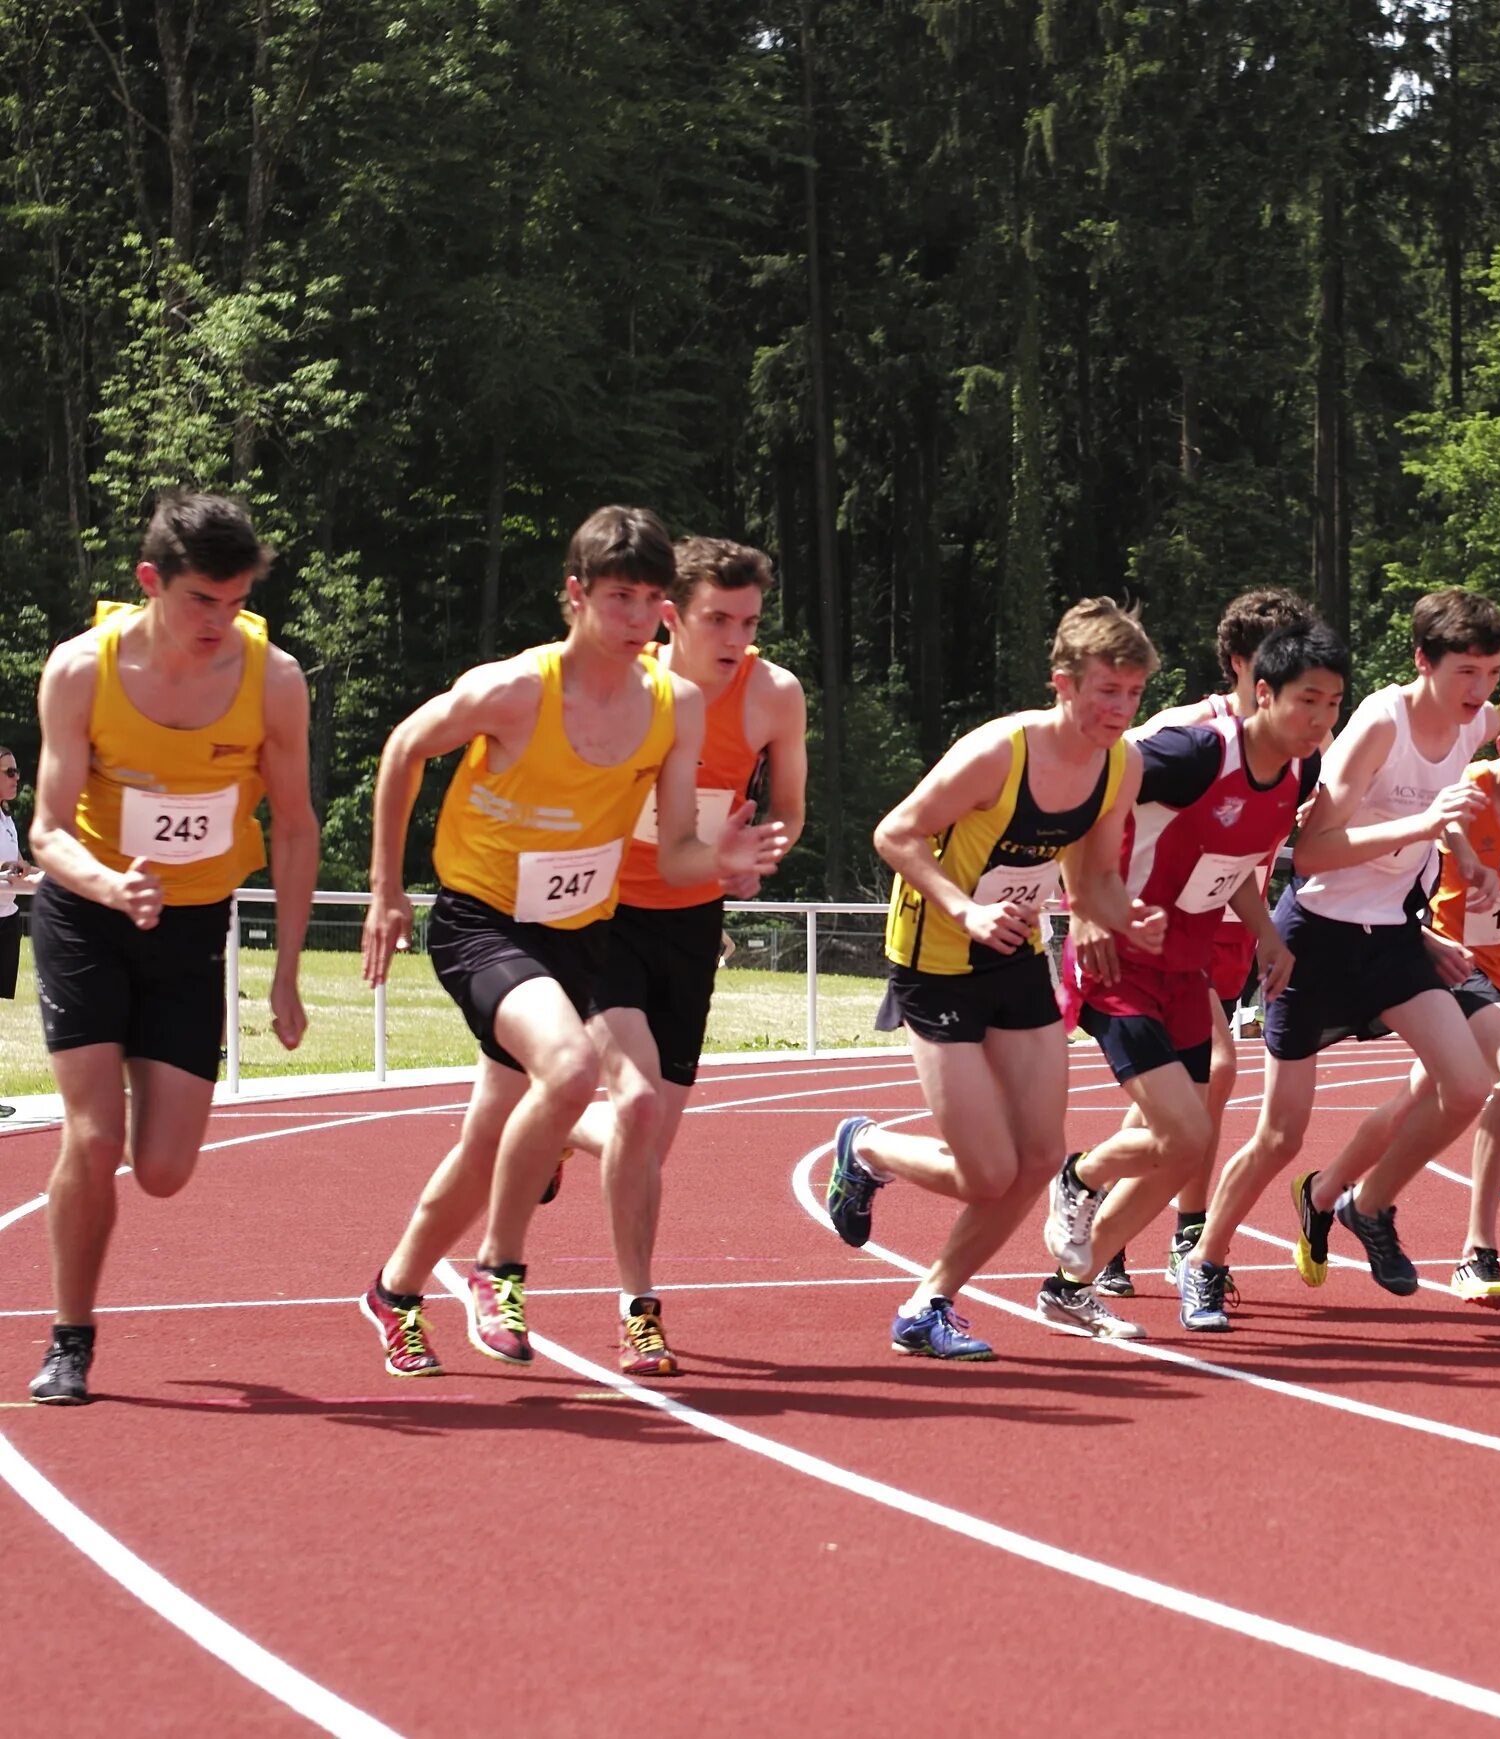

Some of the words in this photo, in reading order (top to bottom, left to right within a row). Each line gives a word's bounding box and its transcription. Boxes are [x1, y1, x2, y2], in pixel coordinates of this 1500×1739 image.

[154, 814, 210, 842] 243
[547, 870, 597, 901] 247
[997, 884, 1040, 905] 224
